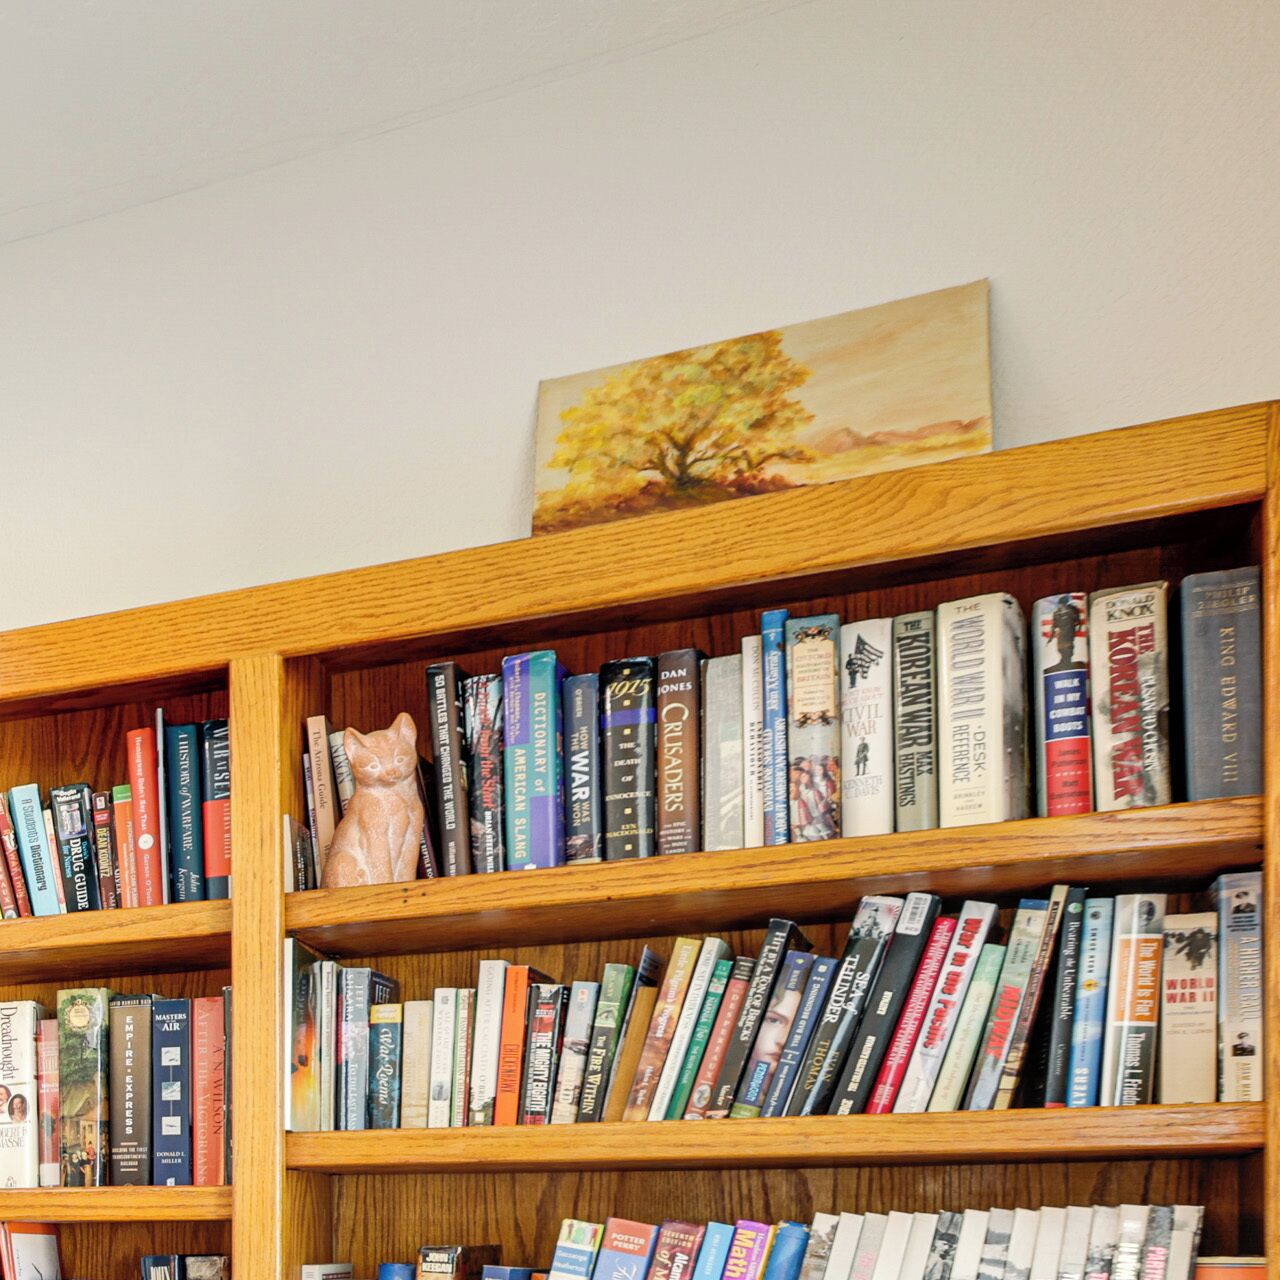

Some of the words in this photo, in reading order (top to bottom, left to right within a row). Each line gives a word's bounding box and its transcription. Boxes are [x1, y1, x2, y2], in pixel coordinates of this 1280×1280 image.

[951, 615, 985, 670] WORLD
[1138, 623, 1154, 655] THE
[1219, 627, 1236, 666] KING
[898, 632, 933, 706] KOREAN
[951, 671, 985, 702] WAR
[1109, 626, 1140, 733] KOREAN
[898, 707, 933, 749] WAR
[951, 704, 985, 721] II
[1222, 676, 1237, 743] EDWARD
[178, 731, 187, 739] A
[535, 693, 545, 772] DICTIONARY
[579, 727, 588, 749] HOW
[973, 732, 987, 770] DESK
[180, 741, 189, 786] HISTORY
[662, 703, 689, 812] CRUSADERS
[917, 751, 933, 776] MAX
[951, 725, 969, 784] REFERENCE
[1111, 735, 1143, 800] WAR
[1223, 753, 1238, 783] VIII
[180, 787, 190, 797] of
[514, 749, 527, 811] AMERICAN
[535, 779, 544, 791] of
[571, 751, 589, 801] WAR
[899, 753, 915, 806] HASTINGS
[23, 806, 38, 843] Student's
[182, 799, 192, 851] WARFARE
[572, 803, 581, 826] WON
[70, 839, 84, 871] DRUG
[515, 819, 526, 858] SLANG
[30, 845, 48, 891] Dictionary
[64, 855, 72, 878] Nurses
[178, 868, 188, 900] Keegan
[190, 872, 199, 892] John
[74, 874, 88, 909] GUIDE
[1140, 942, 1158, 957] The
[823, 955, 859, 1024] THUNDER
[851, 972, 870, 998] SEA
[1137, 960, 1156, 986] World
[844, 1001, 859, 1014] of
[1136, 999, 1153, 1016] Flat
[1137, 989, 1153, 997] is
[126, 1016, 134, 1065] EMPIRE
[198, 1010, 209, 1054] AFTER
[537, 1032, 551, 1047] THE
[987, 986, 1020, 1060] MIDWAY
[379, 1028, 392, 1060] War
[199, 1059, 209, 1088] THE
[532, 1049, 550, 1079] MIGHTY
[376, 1064, 390, 1105] Poems
[530, 1081, 548, 1111] EIGHTH
[126, 1076, 134, 1134] EXPRESS
[198, 1093, 210, 1183] VICTORIANS
[725, 1230, 756, 1278] Math
